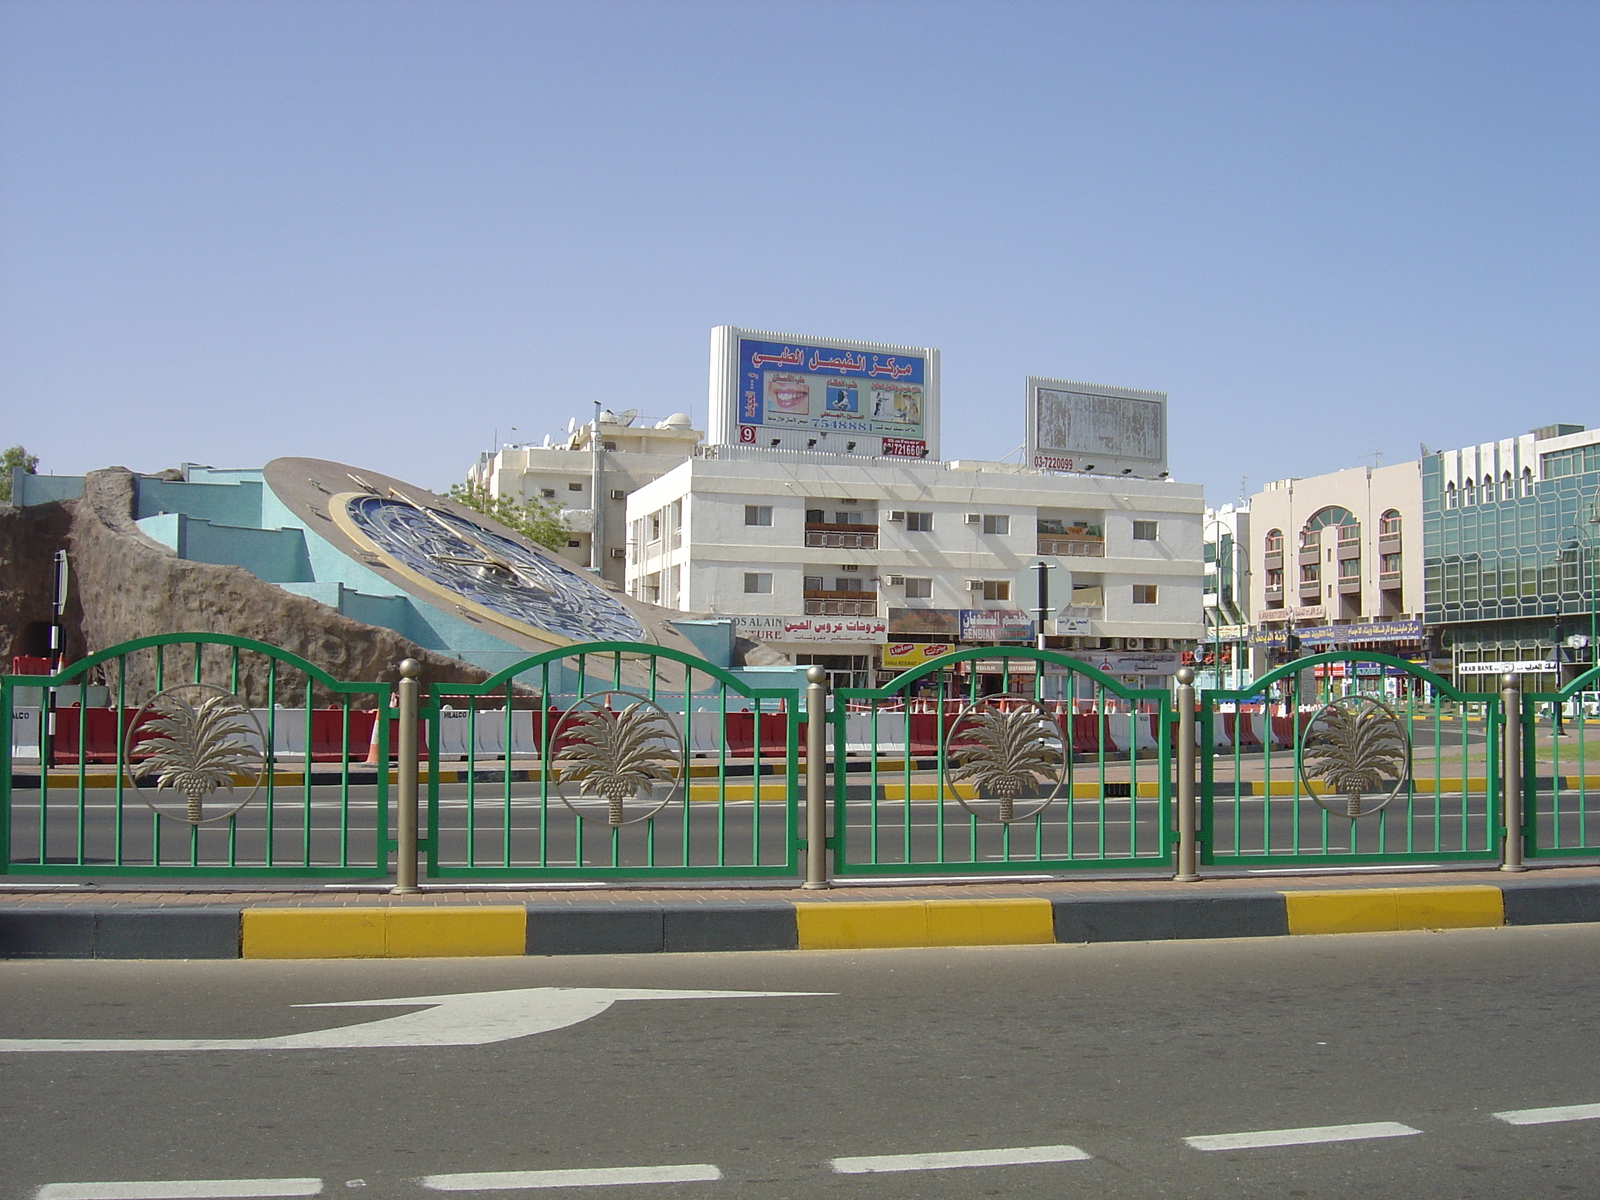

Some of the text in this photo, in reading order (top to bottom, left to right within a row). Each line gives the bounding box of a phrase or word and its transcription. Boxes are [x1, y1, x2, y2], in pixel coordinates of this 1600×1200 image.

[751, 346, 912, 379] مركز الفيصل الطبي
[812, 418, 873, 431] 7548881
[743, 429, 752, 440] 9
[1034, 455, 1073, 470] 03-7220099
[749, 618, 762, 627] AL
[764, 618, 782, 627] AIN
[962, 610, 1032, 628] مطعم السنديان
[784, 619, 886, 634] مفروشات عروس العين
[891, 644, 913, 655] Lipton
